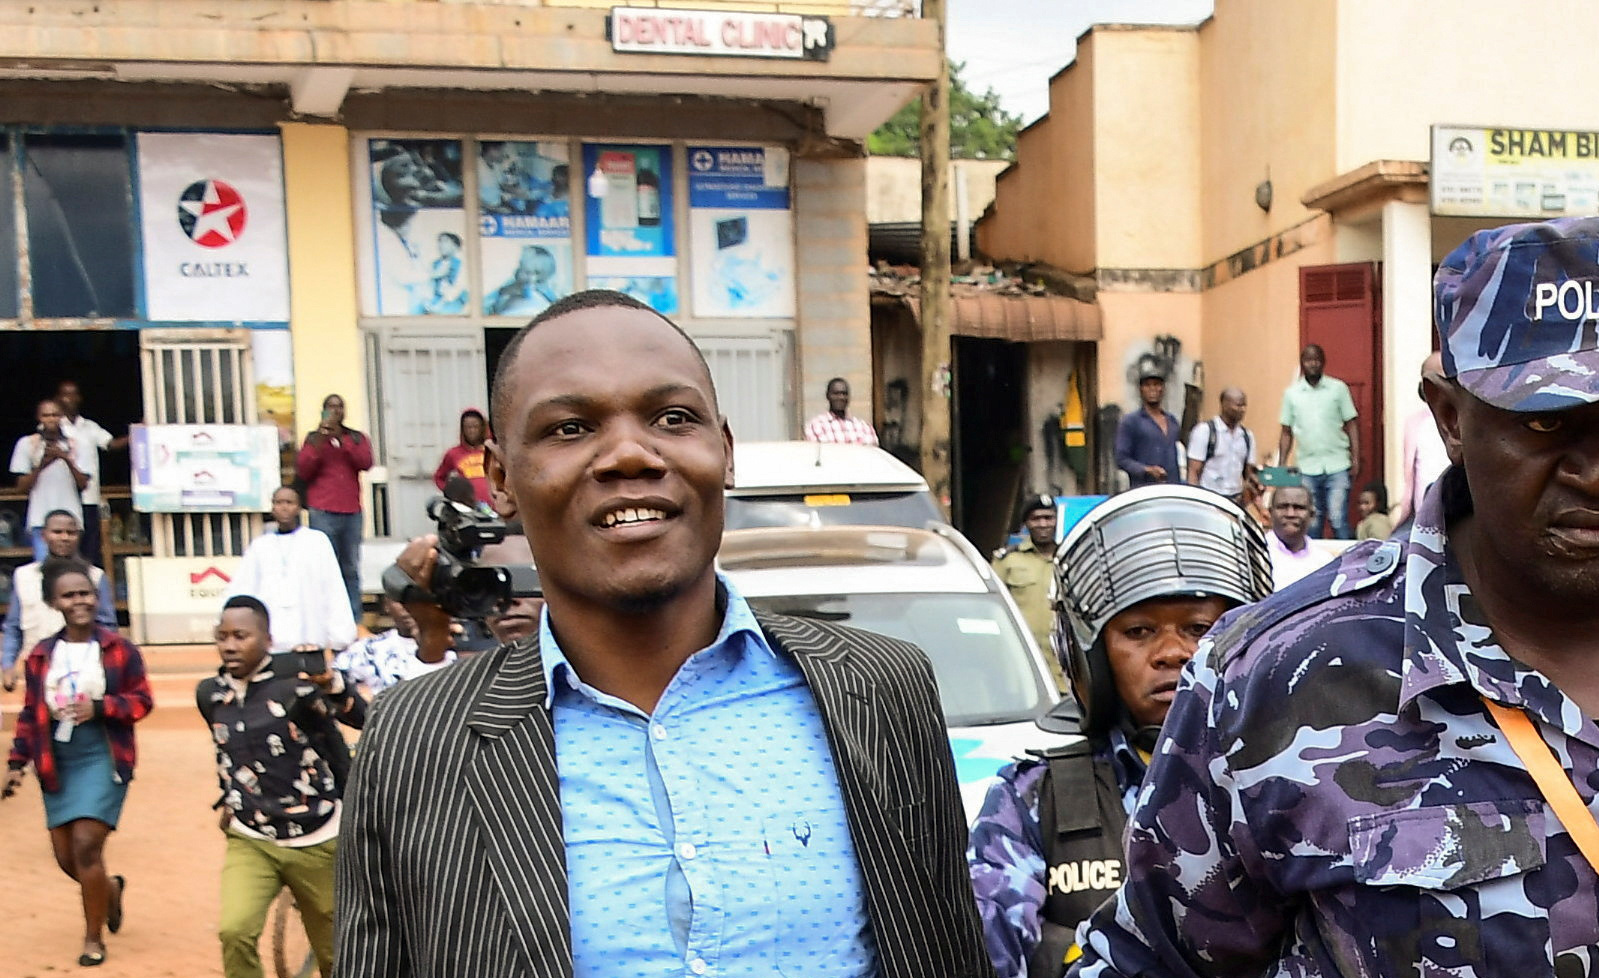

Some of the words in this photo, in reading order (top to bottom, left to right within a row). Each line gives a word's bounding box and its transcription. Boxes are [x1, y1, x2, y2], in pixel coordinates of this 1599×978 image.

[620, 15, 711, 47] DENTAL
[721, 19, 800, 50] CLINIC
[1490, 130, 1566, 158] SHAM
[180, 262, 249, 277] CALTEX
[1048, 860, 1121, 896] POLICE
